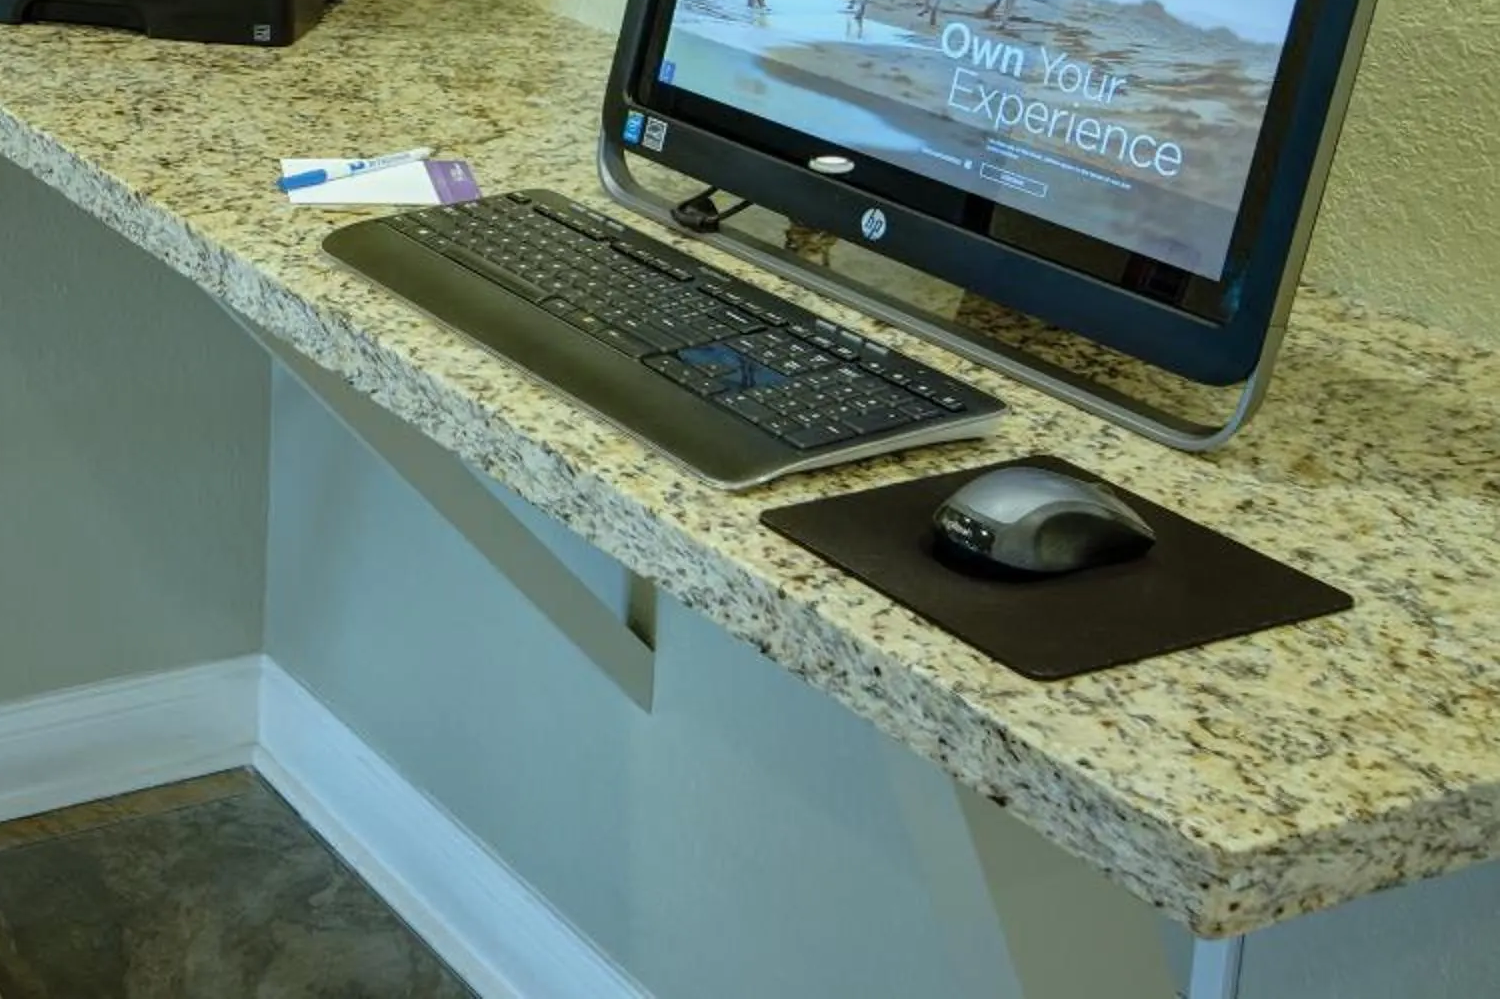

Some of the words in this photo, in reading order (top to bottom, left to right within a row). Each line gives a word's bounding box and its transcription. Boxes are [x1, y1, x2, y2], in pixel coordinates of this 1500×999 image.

[941, 22, 1025, 78] Own
[1040, 46, 1128, 104] Your
[948, 66, 1183, 176] Experience
[862, 209, 885, 240] hp
